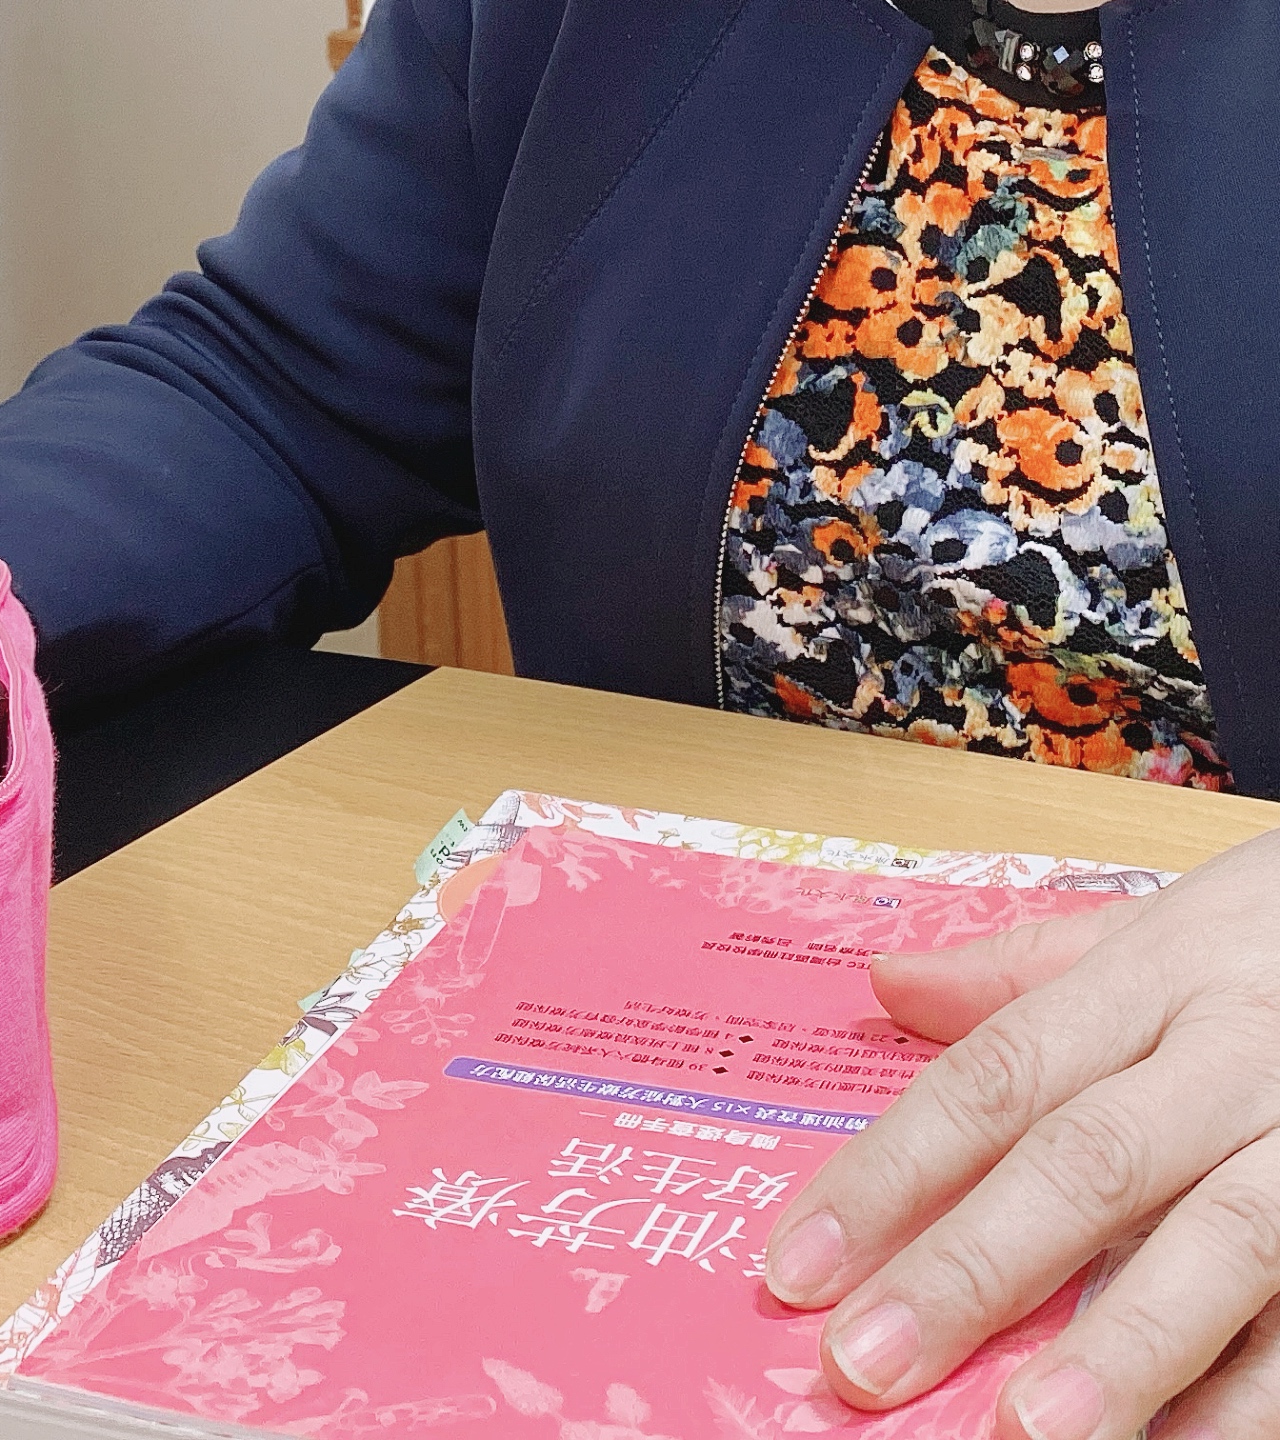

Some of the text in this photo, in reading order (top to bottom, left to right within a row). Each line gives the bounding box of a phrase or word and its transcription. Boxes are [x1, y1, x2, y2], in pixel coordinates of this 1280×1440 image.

[613, 1111, 782, 1151] 隨身速查手冊
[548, 1137, 798, 1211] 好生活
[392, 1167, 768, 1279] 油芳療
